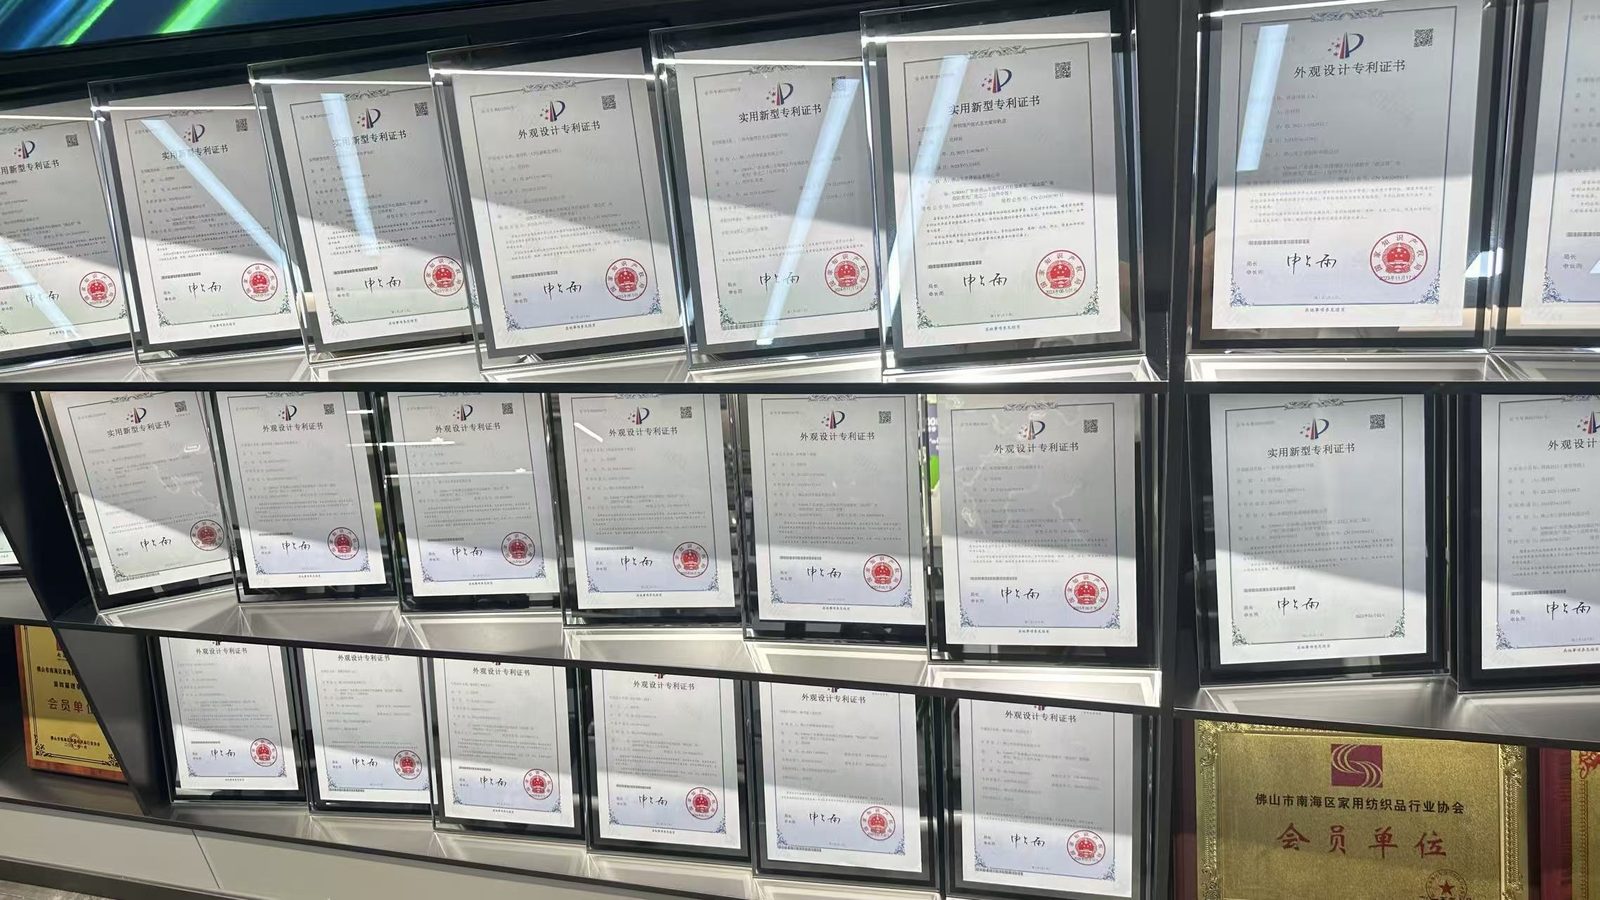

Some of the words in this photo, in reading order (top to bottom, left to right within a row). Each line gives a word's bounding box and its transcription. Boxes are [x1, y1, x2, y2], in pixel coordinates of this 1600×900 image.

[1293, 59, 1406, 79] 外观设计专利证书
[738, 103, 822, 123] 实用新型专利证书
[949, 95, 1040, 116] 实用新型专利证书
[518, 120, 601, 140] 外观设计专利证书
[161, 143, 230, 161] 实专利证书
[107, 420, 171, 438] 实用新型专利证书
[262, 422, 324, 433] 外观设计专利证书
[435, 422, 501, 434] 外观设计专利证书
[608, 426, 678, 438] 外观设计专利证书
[799, 431, 875, 442] 外观设计专利证书
[994, 441, 1079, 454] 外观设计专利证书
[1267, 443, 1356, 459] 实用新型专利证书
[1547, 437, 1600, 452] 外观设计
[472, 666, 531, 677] 外观设计专利证书
[633, 679, 696, 691] 外观设计专利证书
[800, 692, 867, 705] 外观设计专利证书
[1004, 709, 1077, 723] 外观设计专利证书
[1255, 793, 1466, 815] 佛山市南海区家用纺织品行业协会
[1276, 822, 1448, 859] 会员单位
